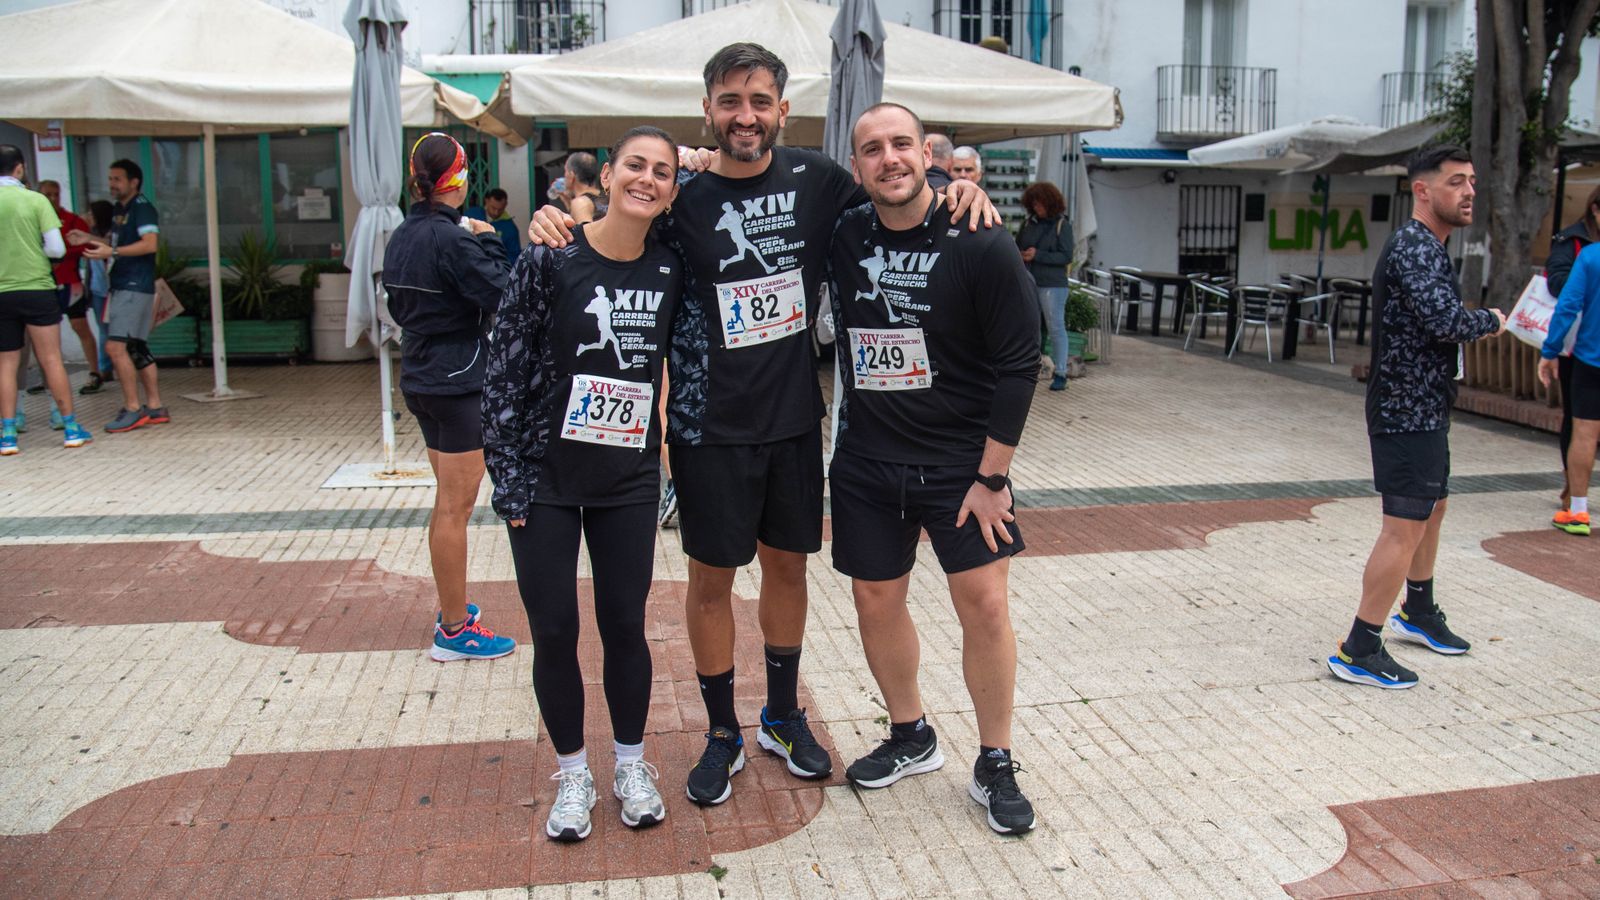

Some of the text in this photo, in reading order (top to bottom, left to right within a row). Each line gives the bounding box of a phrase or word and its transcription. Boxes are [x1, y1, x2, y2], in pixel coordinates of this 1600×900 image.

[741, 191, 796, 219] XIV
[743, 214, 791, 229] CARRERA
[745, 220, 796, 235] ESTRECHO
[1269, 208, 1368, 250] LIMA
[759, 239, 785, 249] PEPE
[761, 241, 805, 255] SERRANO
[777, 257, 785, 266] 8
[888, 251, 940, 272] XIV
[880, 278, 928, 288] ESTRECHO
[881, 272, 925, 280] CARRERA
[732, 284, 760, 299] XIV
[760, 278, 787, 288] CARRERA
[761, 280, 800, 295] DEL ESTRECHO
[614, 289, 664, 312] XIV
[750, 294, 780, 321] 82
[612, 312, 654, 320] CARRERA
[612, 320, 656, 328] ESTRECHO
[620, 336, 645, 344] PEPE
[859, 333, 879, 345] XIV
[632, 355, 639, 364] 8
[866, 345, 905, 369] 249
[587, 380, 617, 396] XIV
[617, 385, 642, 394] CARRERA
[590, 395, 634, 425] 378
